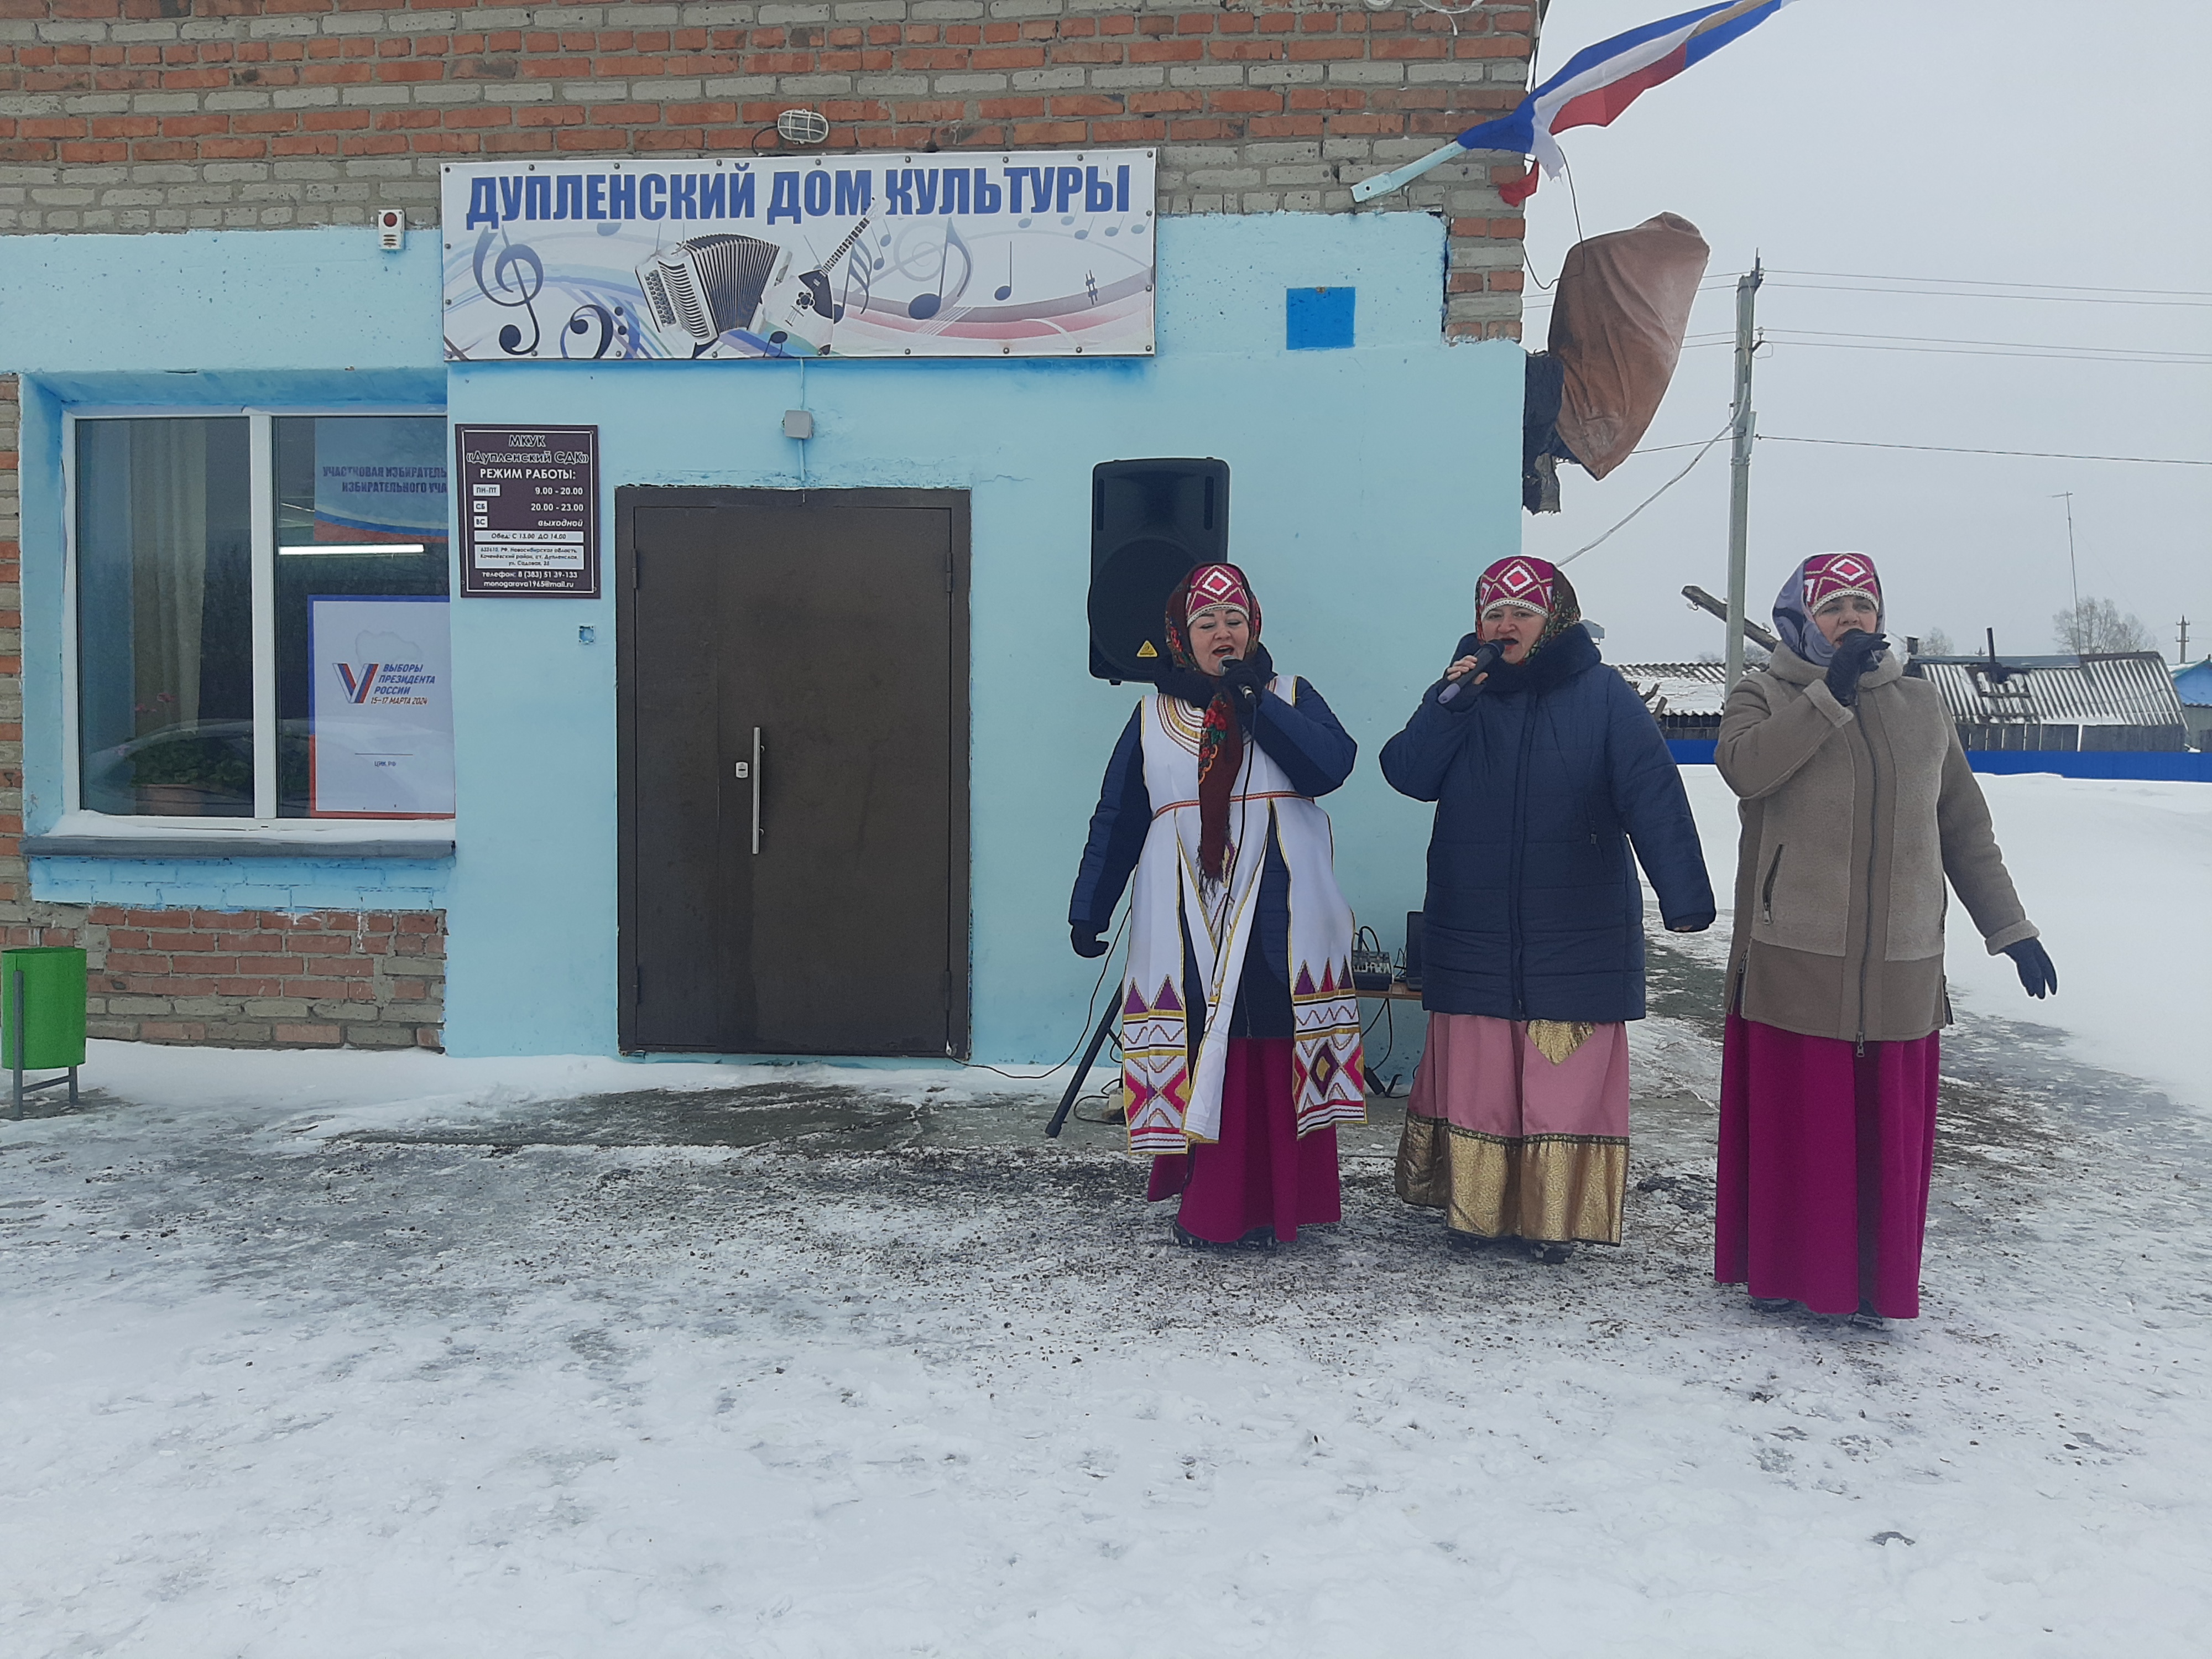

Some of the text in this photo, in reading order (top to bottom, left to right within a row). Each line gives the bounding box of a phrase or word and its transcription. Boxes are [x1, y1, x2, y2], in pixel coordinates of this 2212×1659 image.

[466, 163, 1130, 231] ДУПЛЕНСКИЙ ДОМ КУЛЬТУРЫ
[508, 435, 546, 447] МКУК
[466, 450, 589, 465] «Дупленский СДК»
[322, 466, 384, 477] УЧАСТКОВАЯ
[480, 468, 576, 479] РЕЖИМ РАБОТЫ:
[342, 482, 426, 493] ИЗБИРАТЕЛЬНОГО
[535, 487, 553, 495] 9.00
[560, 487, 583, 495] 20.00
[531, 503, 554, 512] 20.00
[561, 504, 583, 512] 23.00
[538, 519, 583, 527] выходной
[524, 571, 542, 579] (383)
[383, 664, 424, 672] ВЫБОРЫ
[378, 675, 436, 685] ПРЕЗИДЕНТА
[374, 686, 411, 695] РОССИИ
